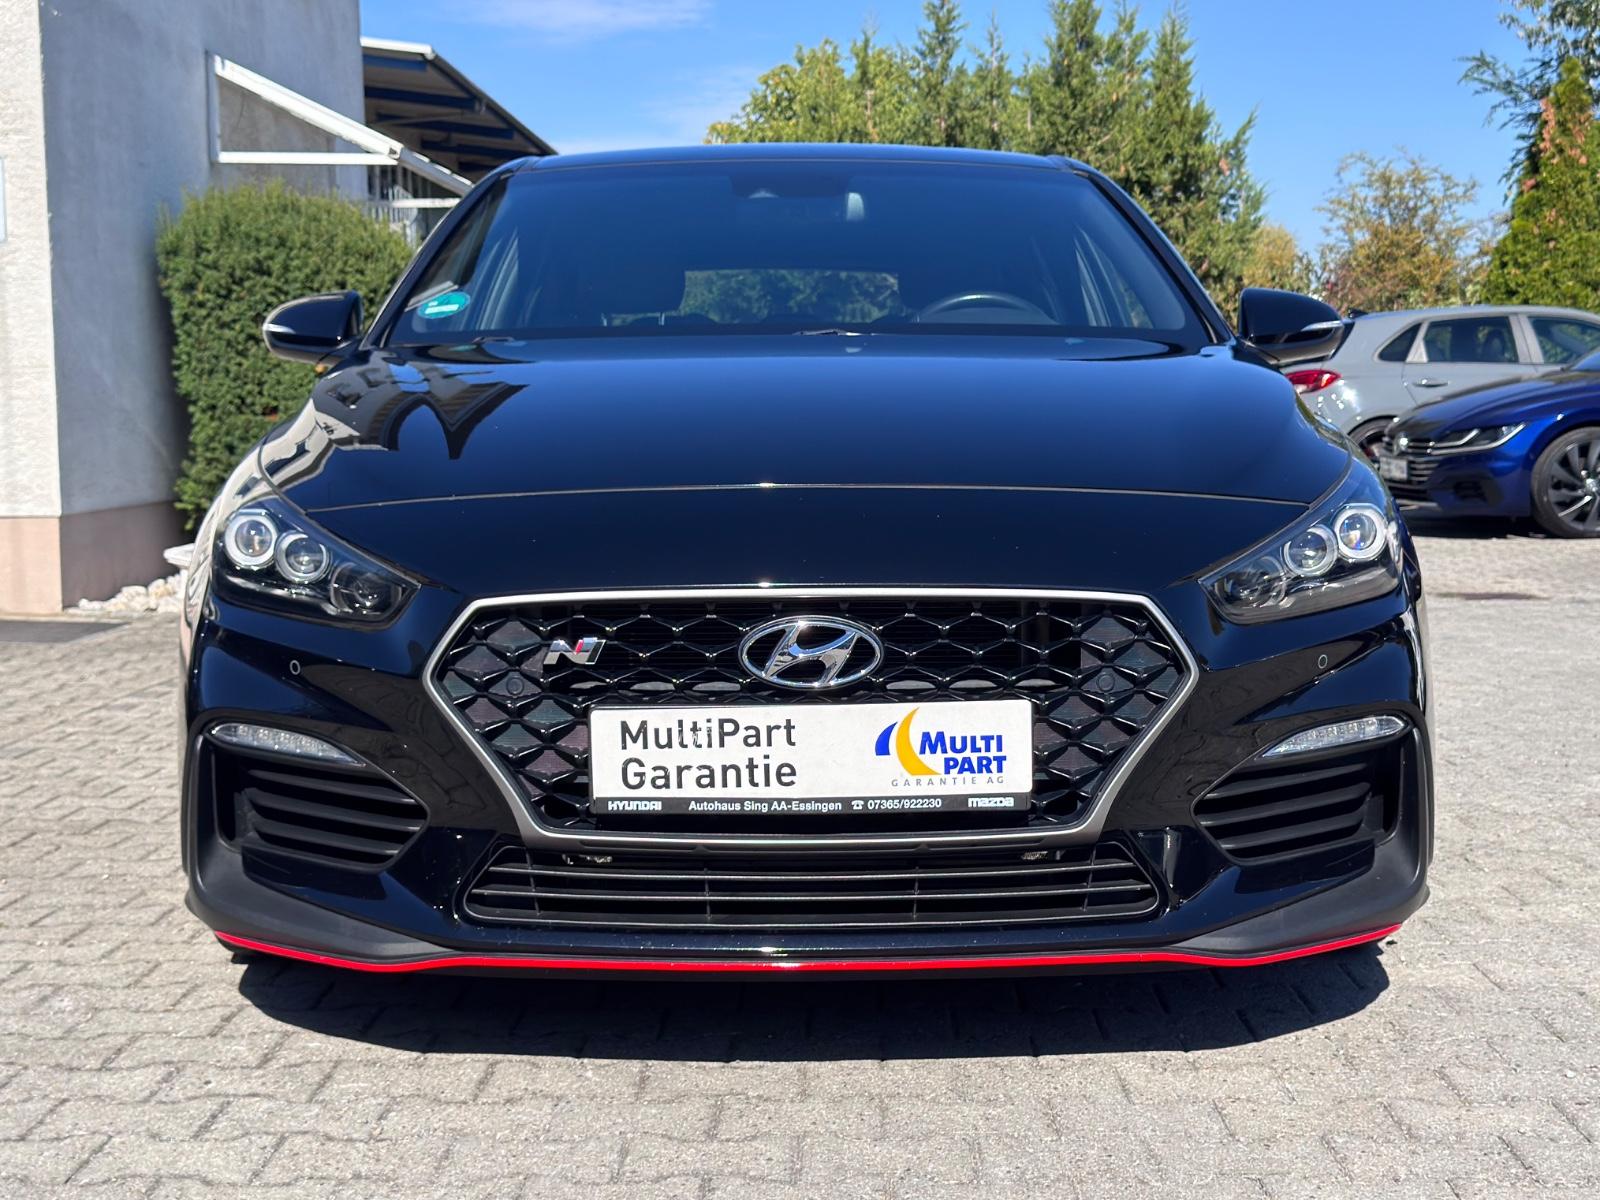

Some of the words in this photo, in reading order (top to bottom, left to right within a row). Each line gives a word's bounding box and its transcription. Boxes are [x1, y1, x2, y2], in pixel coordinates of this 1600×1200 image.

[620, 718, 797, 750] MultiPart
[919, 731, 1004, 755] MULTI
[621, 754, 798, 790] Garantie
[943, 755, 1008, 775] PART
[891, 776, 978, 787] GARANTIE
[987, 775, 1005, 785] AG
[607, 800, 663, 812] HYUNDAI
[688, 800, 742, 812] Autohaus
[743, 800, 769, 813] Sing
[770, 800, 843, 813] AA-Essingen
[867, 798, 942, 811] 07365/922230
